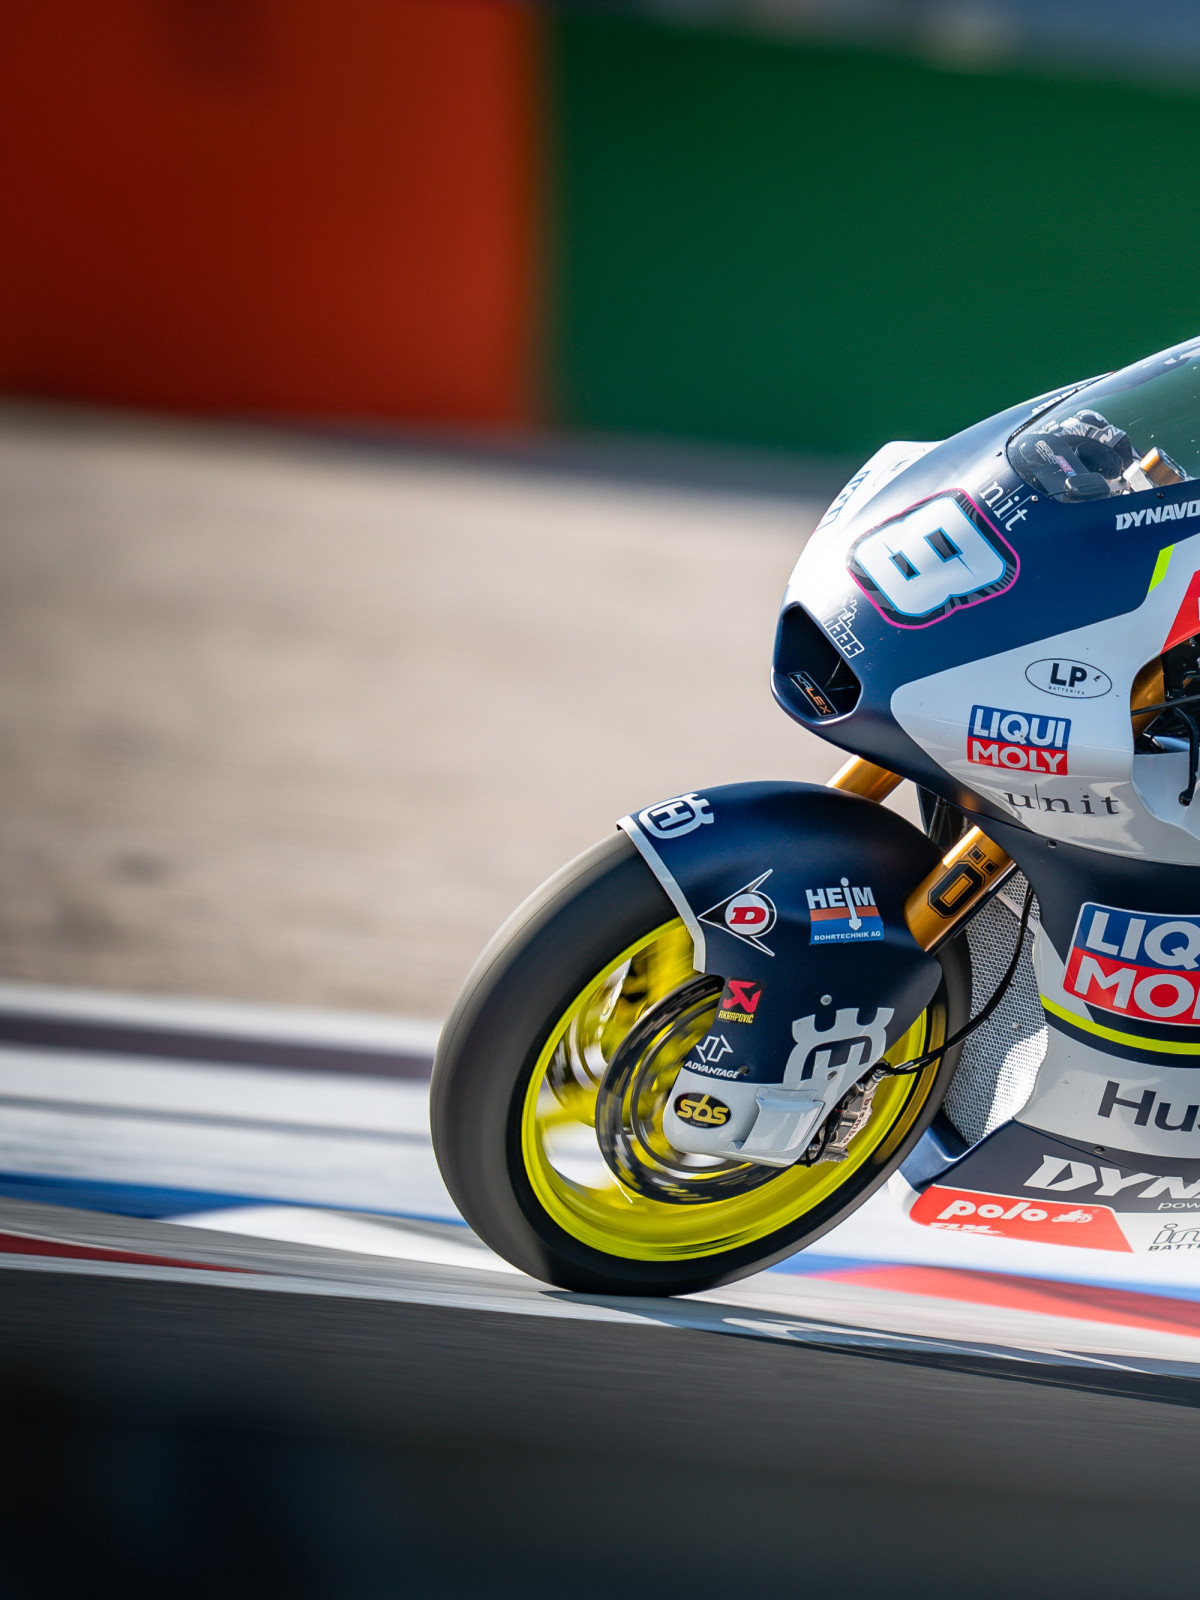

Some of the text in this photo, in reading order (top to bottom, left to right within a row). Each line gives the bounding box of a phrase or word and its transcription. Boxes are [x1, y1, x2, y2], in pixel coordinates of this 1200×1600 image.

[854, 496, 1006, 616] 8
[1050, 663, 1088, 688] LP
[794, 673, 831, 714] KALEX
[1048, 686, 1085, 696] BATTERIES
[973, 708, 1067, 748] LIQUI
[972, 740, 1065, 773] MOLY
[814, 930, 882, 942] BOHRTECHNIK AG
[685, 1061, 740, 1079] ADVANTAGE
[843, 1098, 872, 1145] brembo
[936, 1200, 1048, 1221] polo
